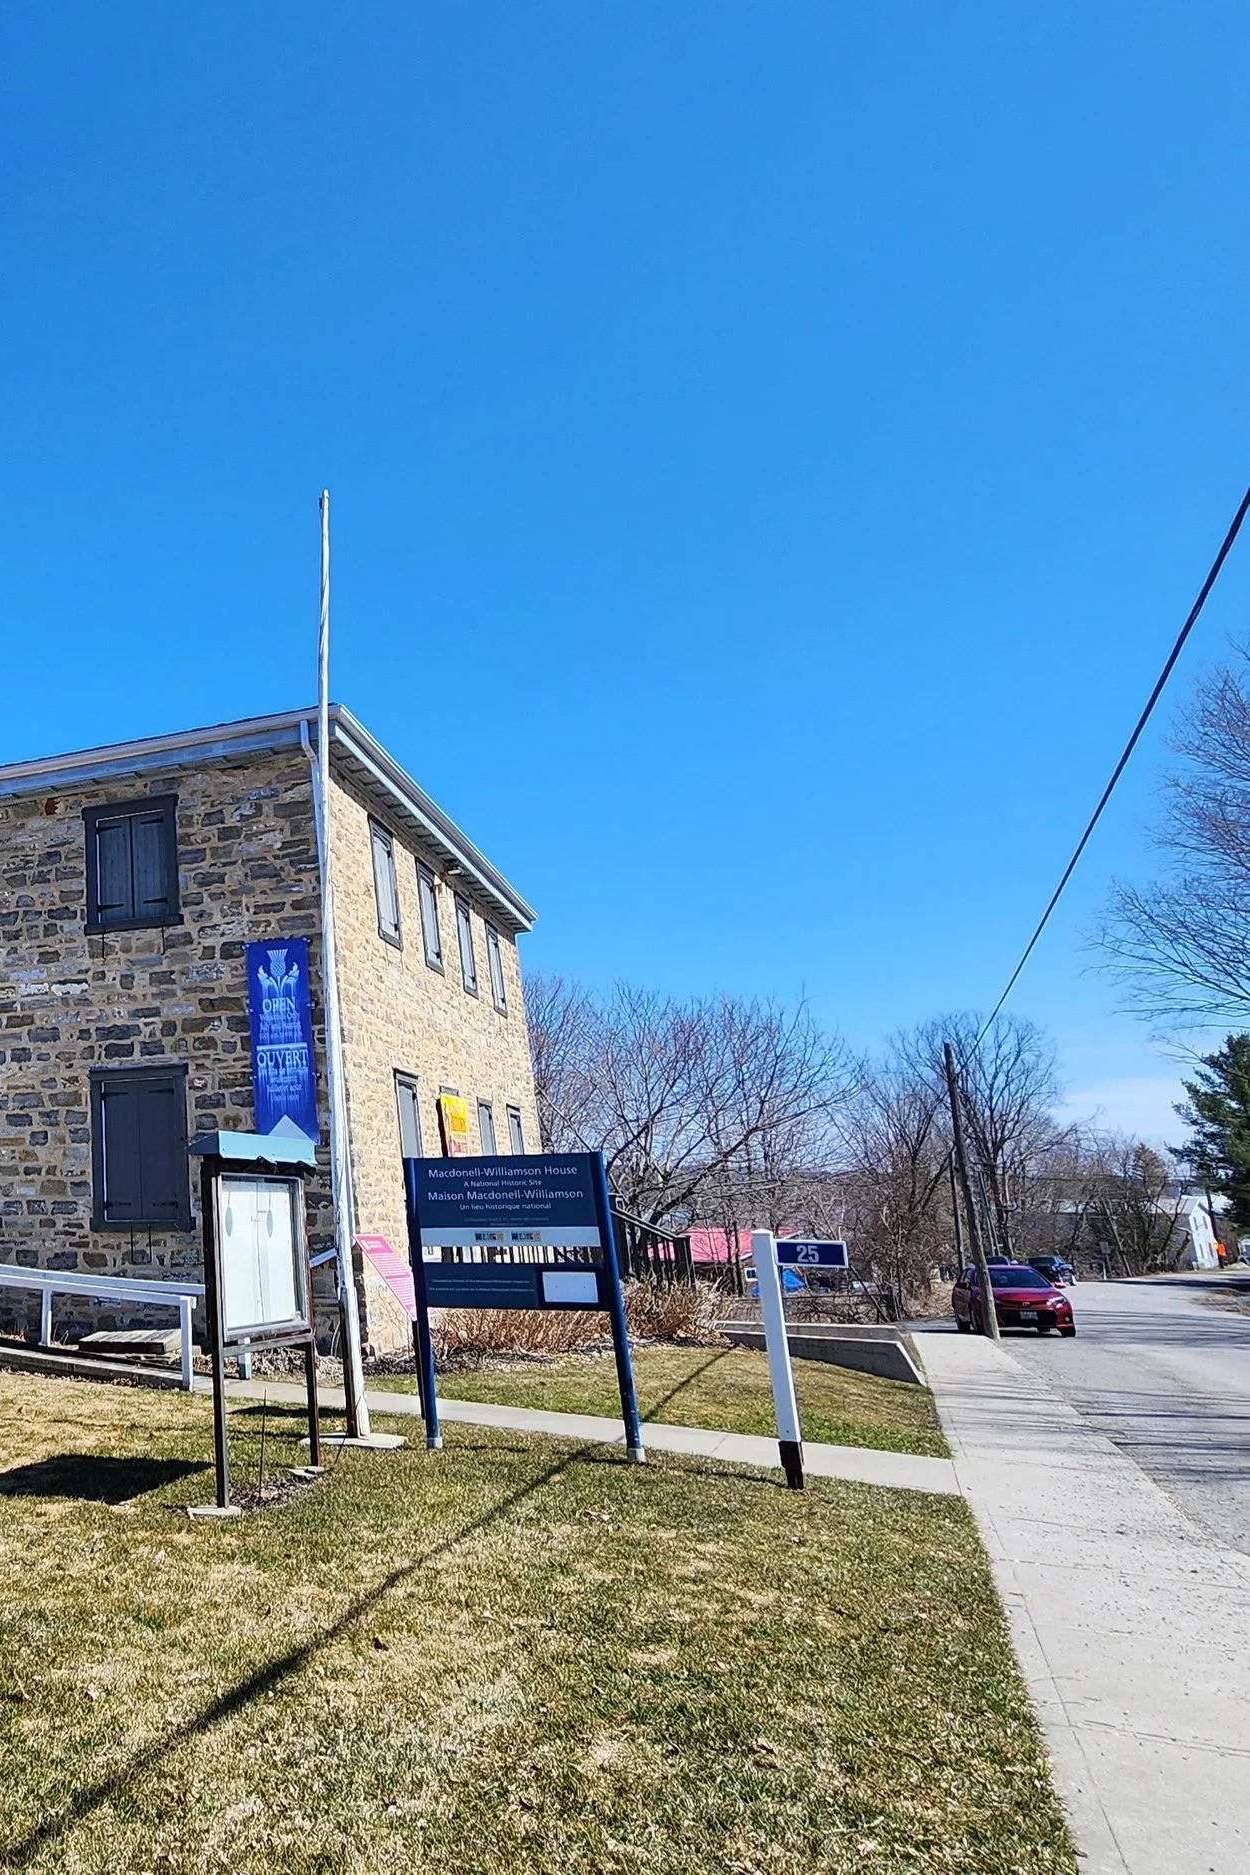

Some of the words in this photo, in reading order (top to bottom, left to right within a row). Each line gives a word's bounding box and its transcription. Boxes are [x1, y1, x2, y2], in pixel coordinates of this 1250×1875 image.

[262, 996, 296, 1013] OPEN
[257, 1049, 308, 1067] OUVERT
[428, 1166, 542, 1178] Macdonell-Williamson
[544, 1165, 578, 1176] House
[501, 1179, 528, 1187] Historic
[428, 1191, 464, 1201] Maison
[467, 1189, 584, 1201] Macdonell-Williamson
[486, 1203, 520, 1211] historique
[522, 1202, 552, 1210] national
[796, 1245, 820, 1263] 25
